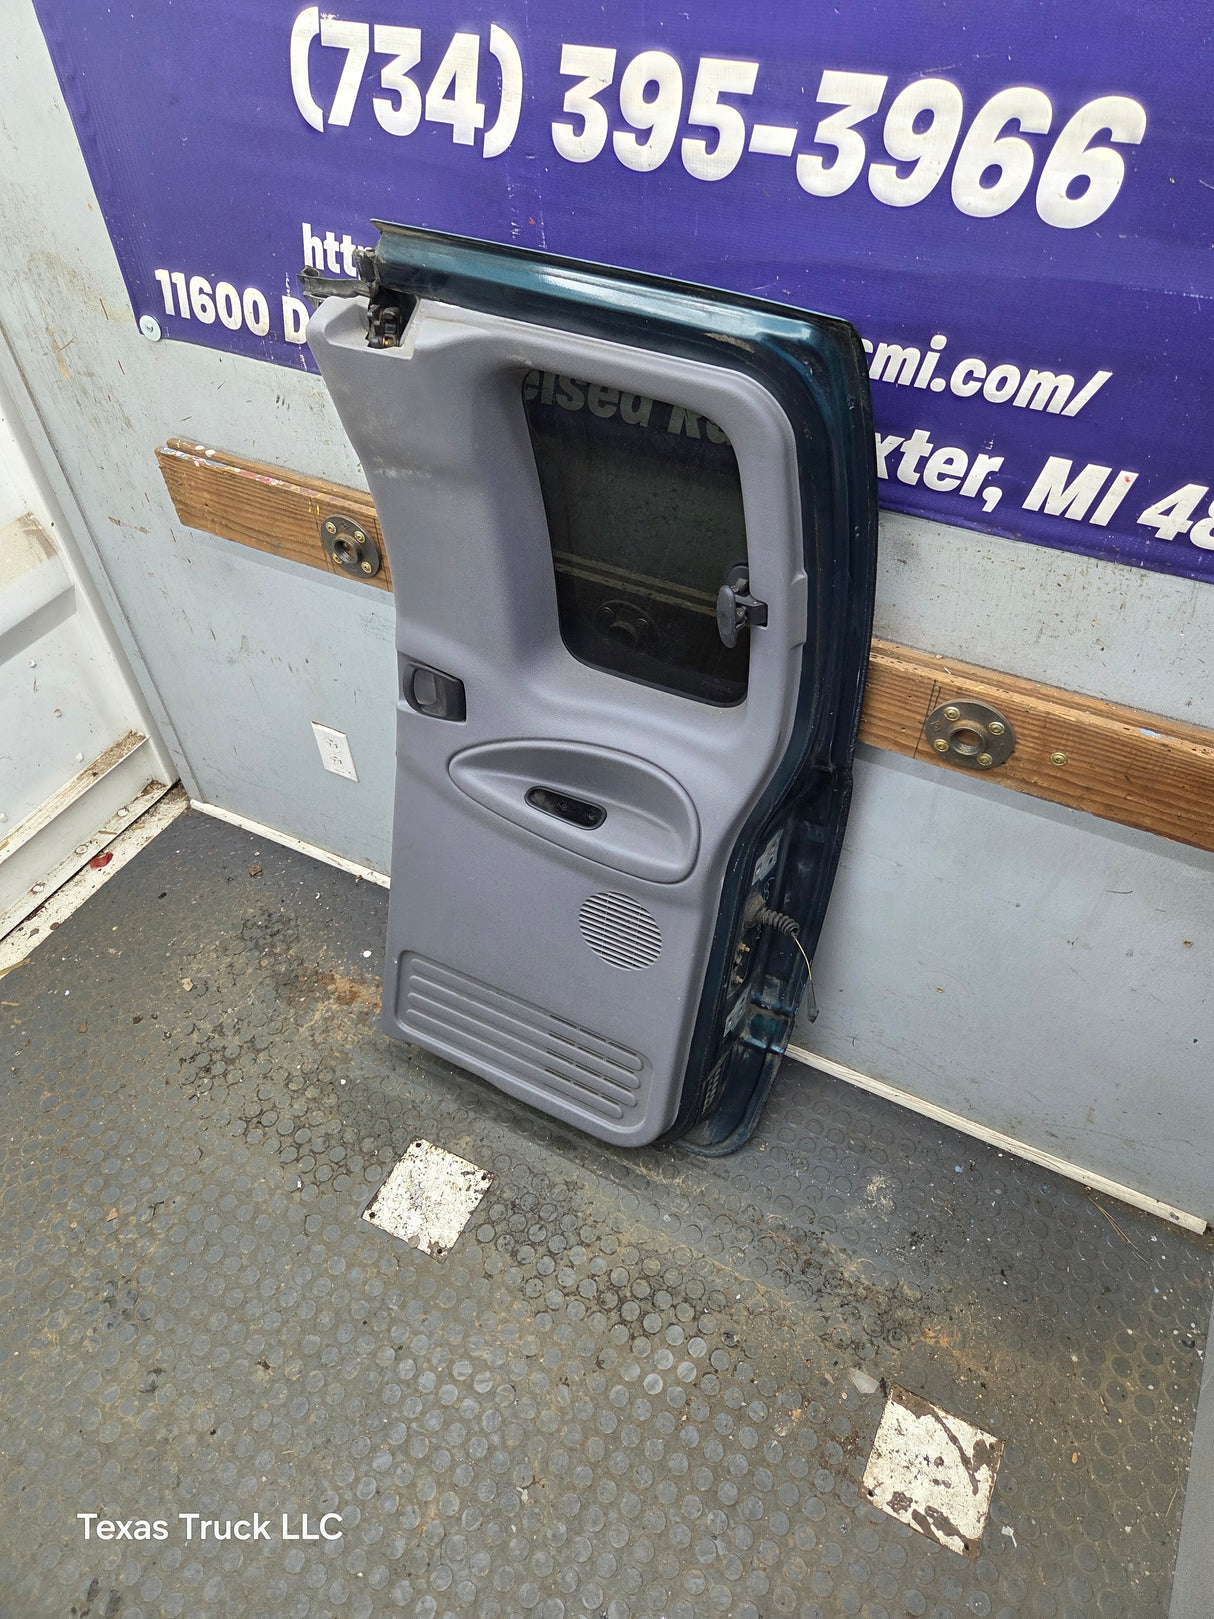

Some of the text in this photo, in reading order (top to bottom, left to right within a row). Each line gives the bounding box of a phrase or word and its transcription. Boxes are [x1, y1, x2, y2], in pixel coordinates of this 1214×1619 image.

[290, 6, 1147, 229] (734) 395-3966
[302, 222, 372, 280] htt
[154, 269, 270, 337] 11600
[1021, 456, 1139, 526] MI
